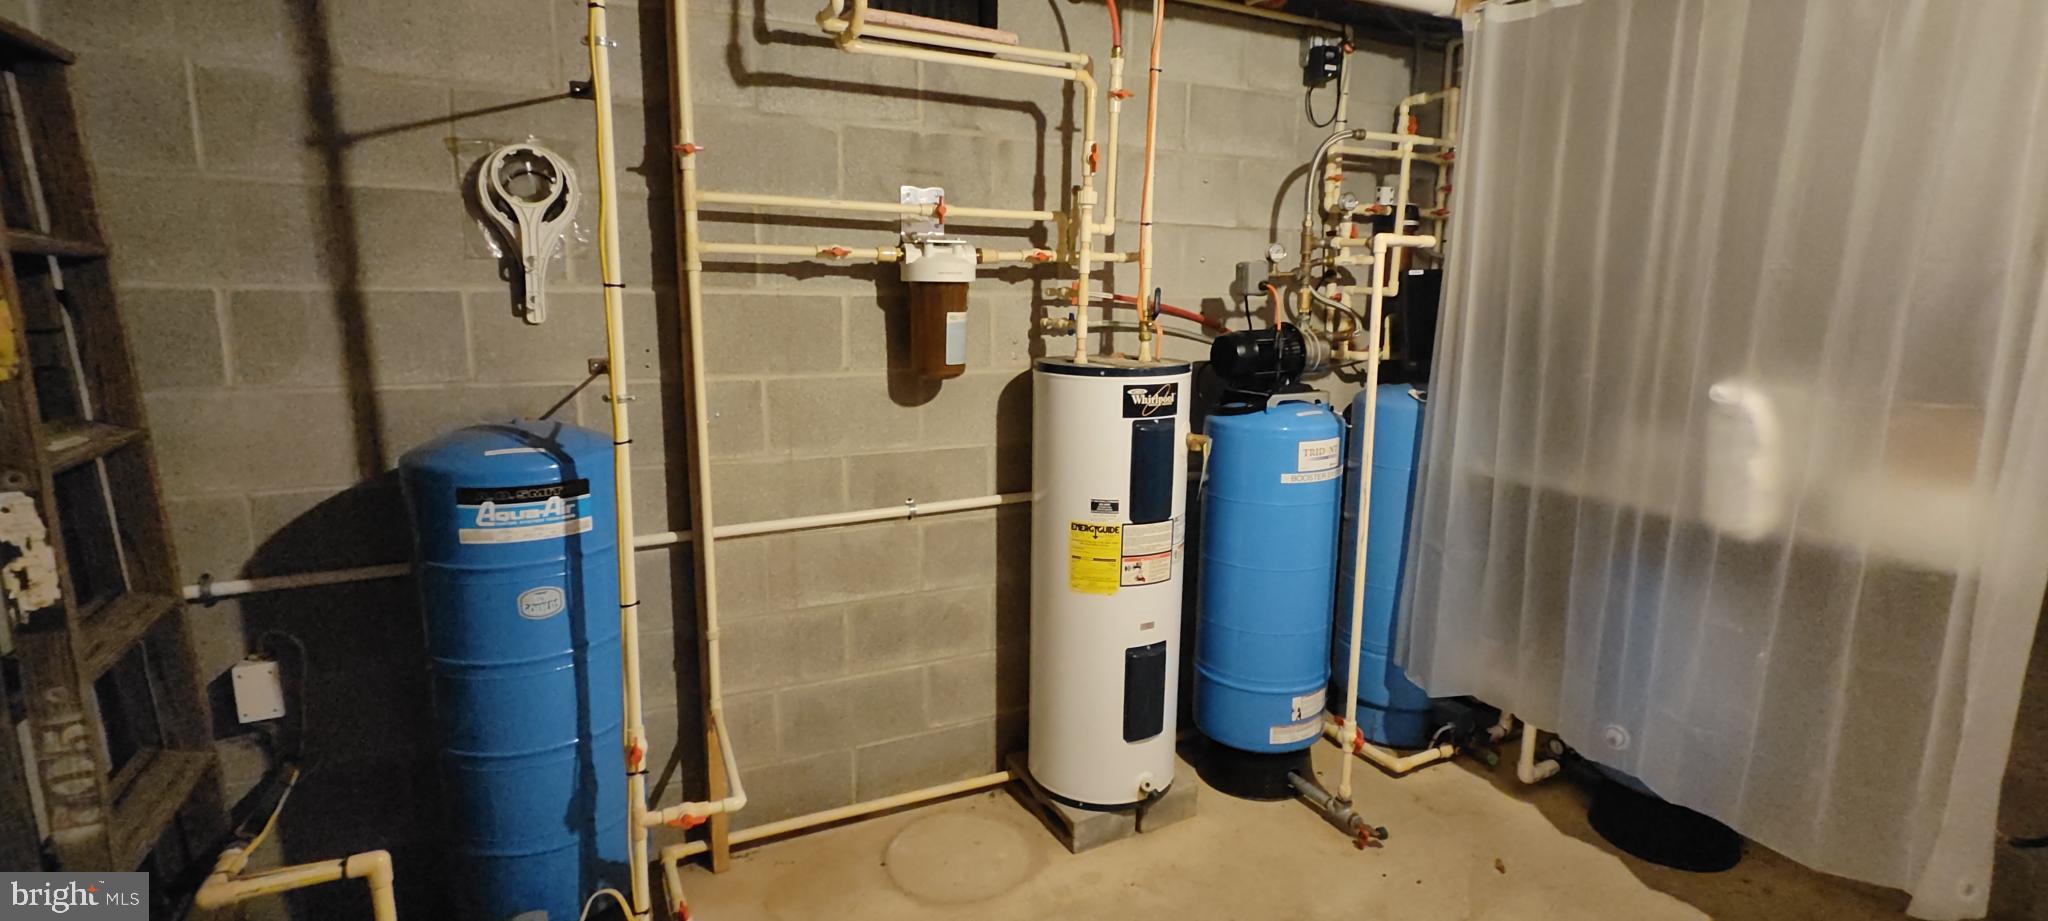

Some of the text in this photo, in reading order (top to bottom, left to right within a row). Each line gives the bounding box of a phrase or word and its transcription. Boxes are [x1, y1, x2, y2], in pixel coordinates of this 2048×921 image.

[1131, 391, 1175, 407] Whirlpool
[1303, 444, 1338, 457] TRIDNT
[475, 496, 577, 527] Aqua-Air
